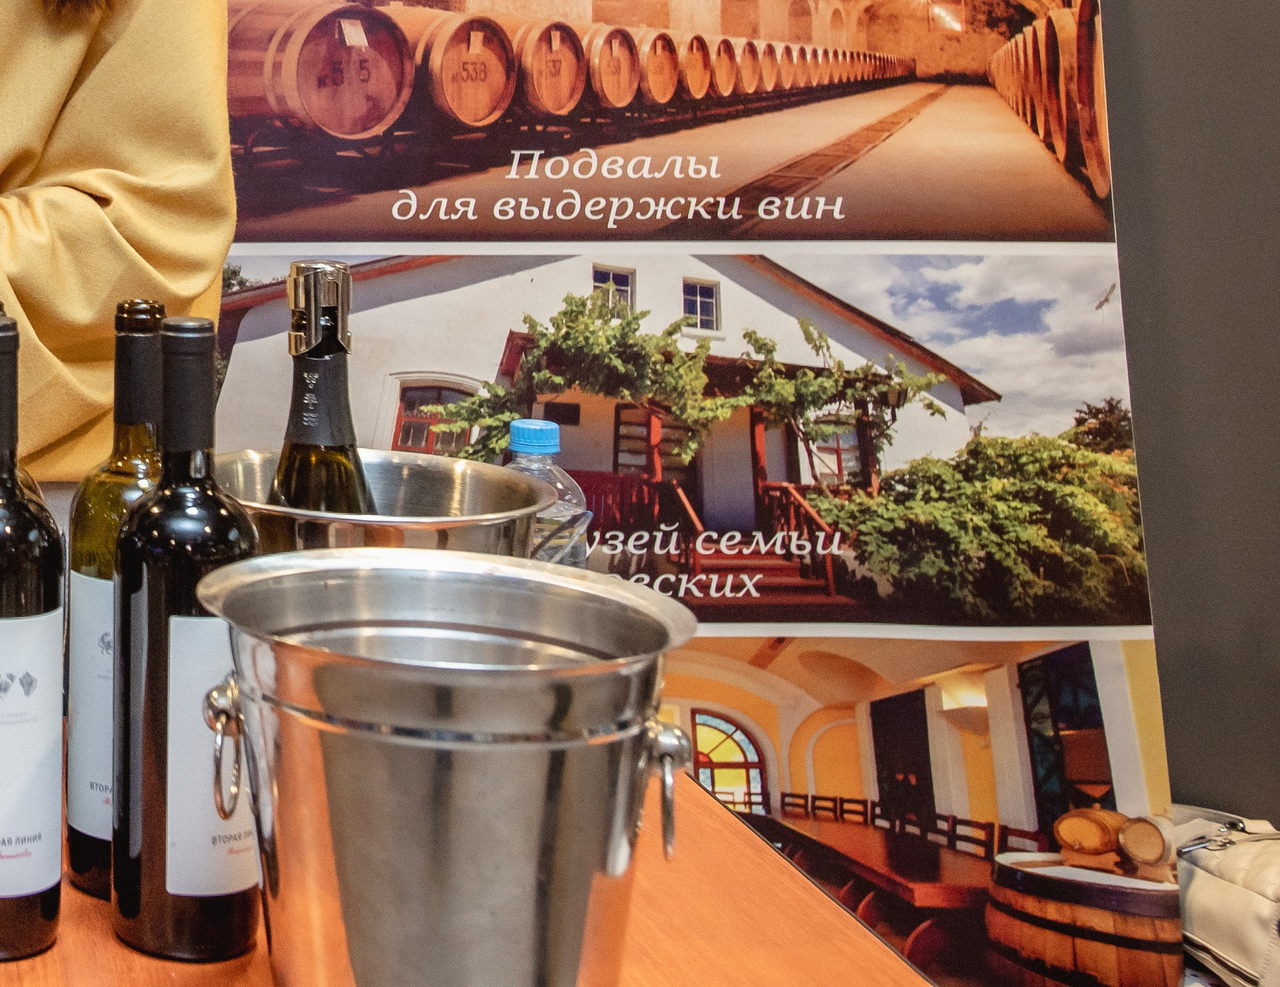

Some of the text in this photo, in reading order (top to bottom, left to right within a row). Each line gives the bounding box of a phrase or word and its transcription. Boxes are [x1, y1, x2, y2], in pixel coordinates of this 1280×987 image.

[505, 148, 721, 180] Подвалы
[391, 189, 846, 229] для выдержки вин
[586, 522, 845, 558] узей семьи
[15, 832, 42, 846] ЛИНИЯ
